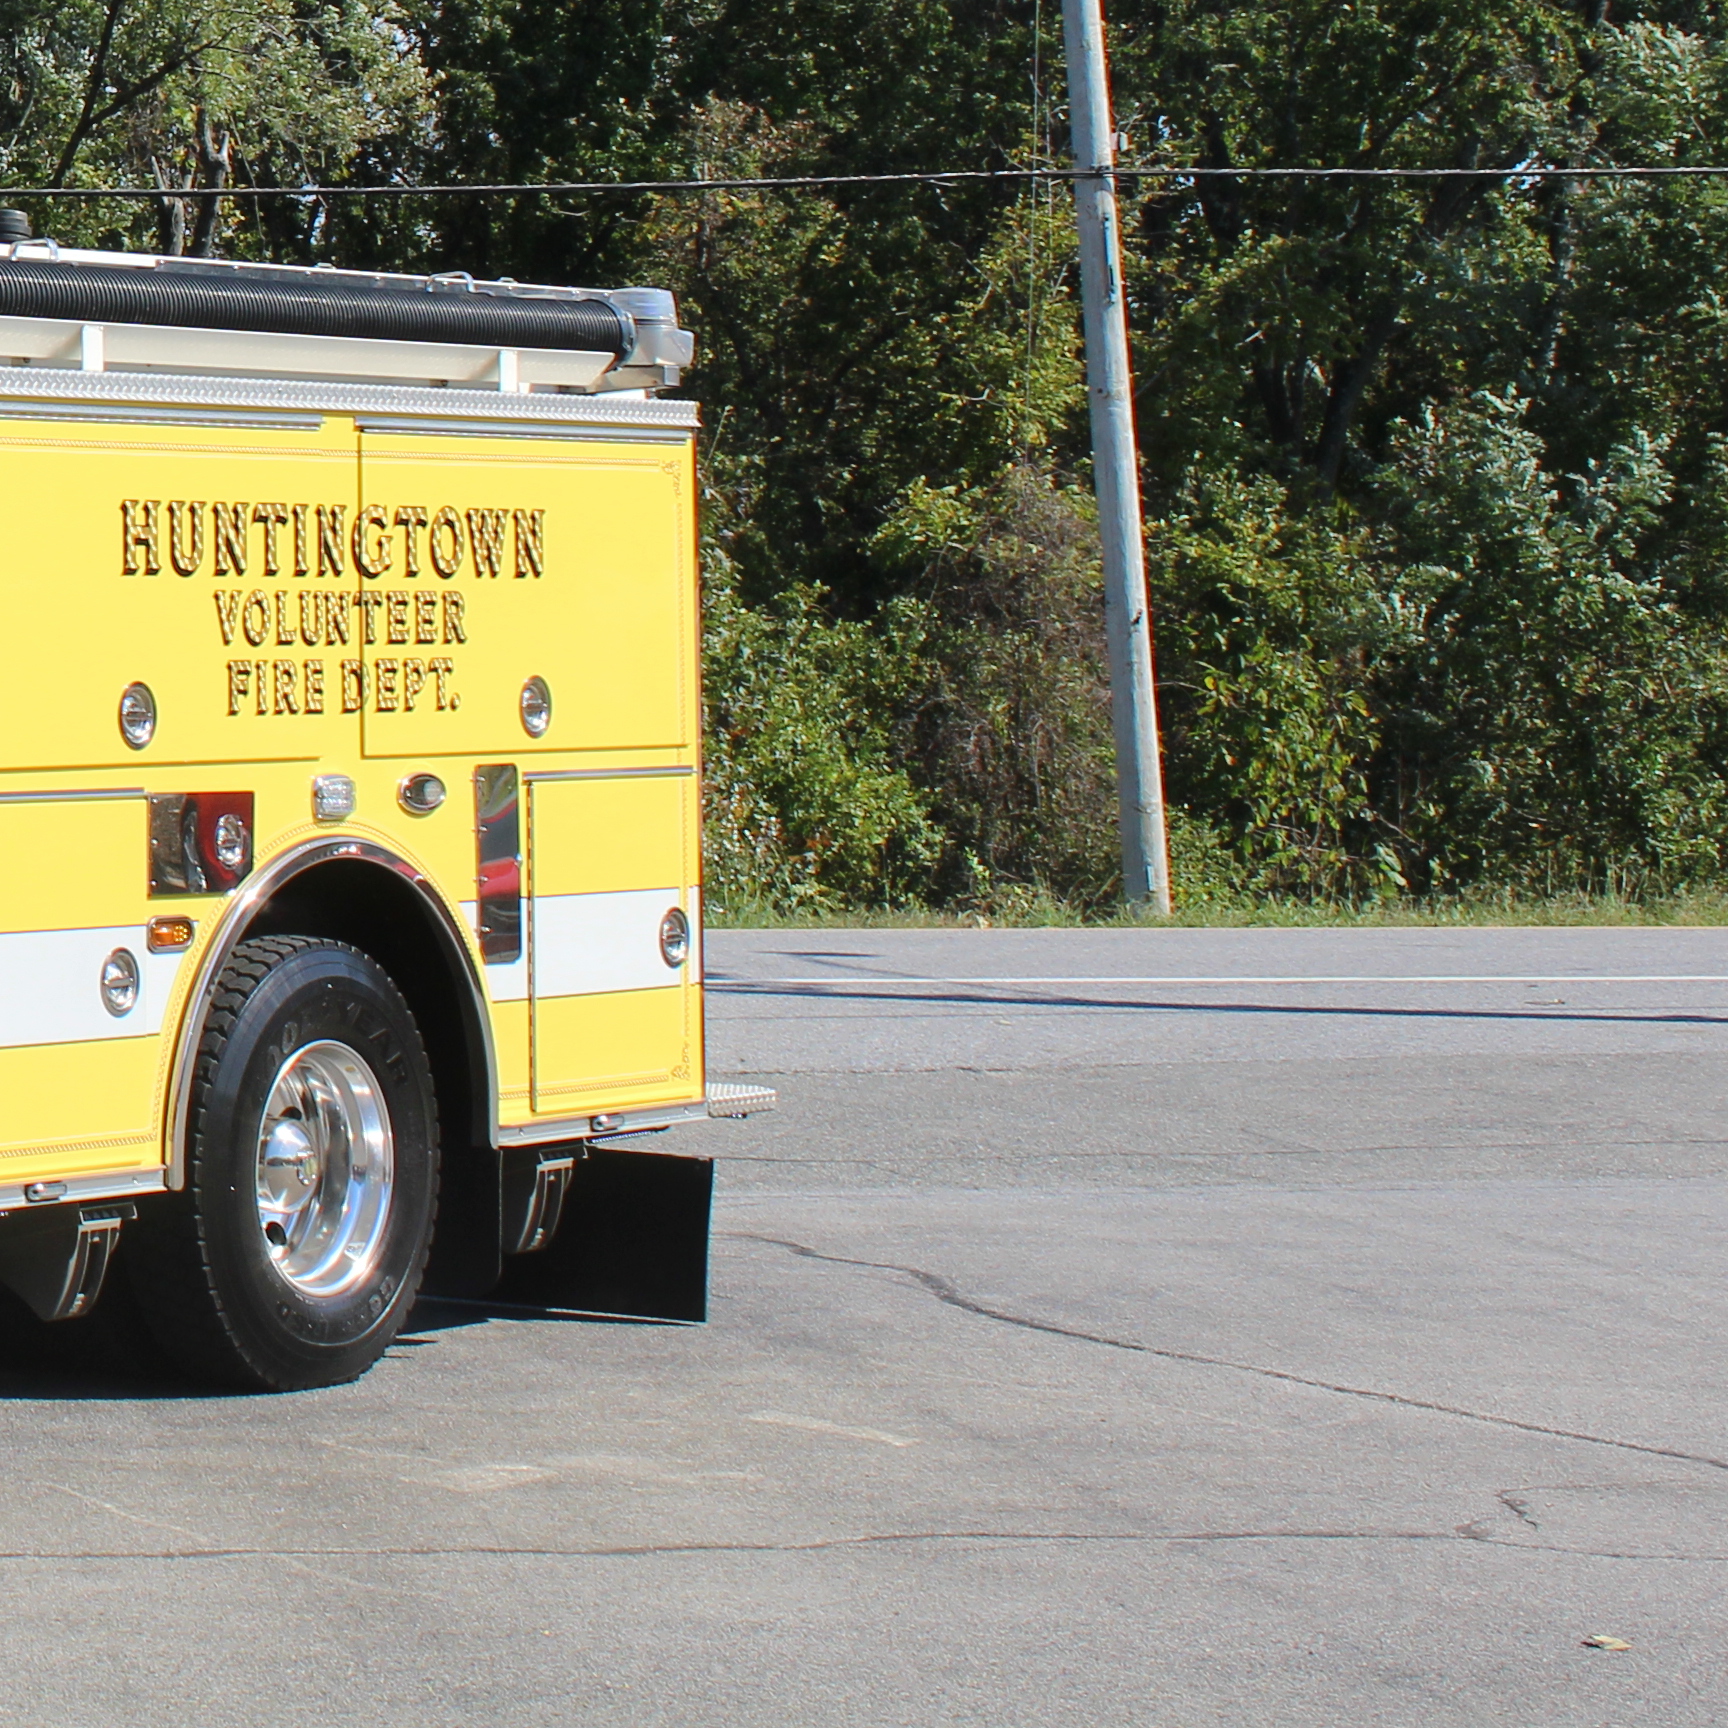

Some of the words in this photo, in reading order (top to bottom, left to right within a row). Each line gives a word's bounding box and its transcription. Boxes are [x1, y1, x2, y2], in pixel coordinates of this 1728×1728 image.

[120, 499, 545, 579] HUNTINGTOWN
[213, 588, 468, 647] VOLUNTEER
[225, 659, 325, 717] FIRE
[338, 657, 462, 715] DEPT.
